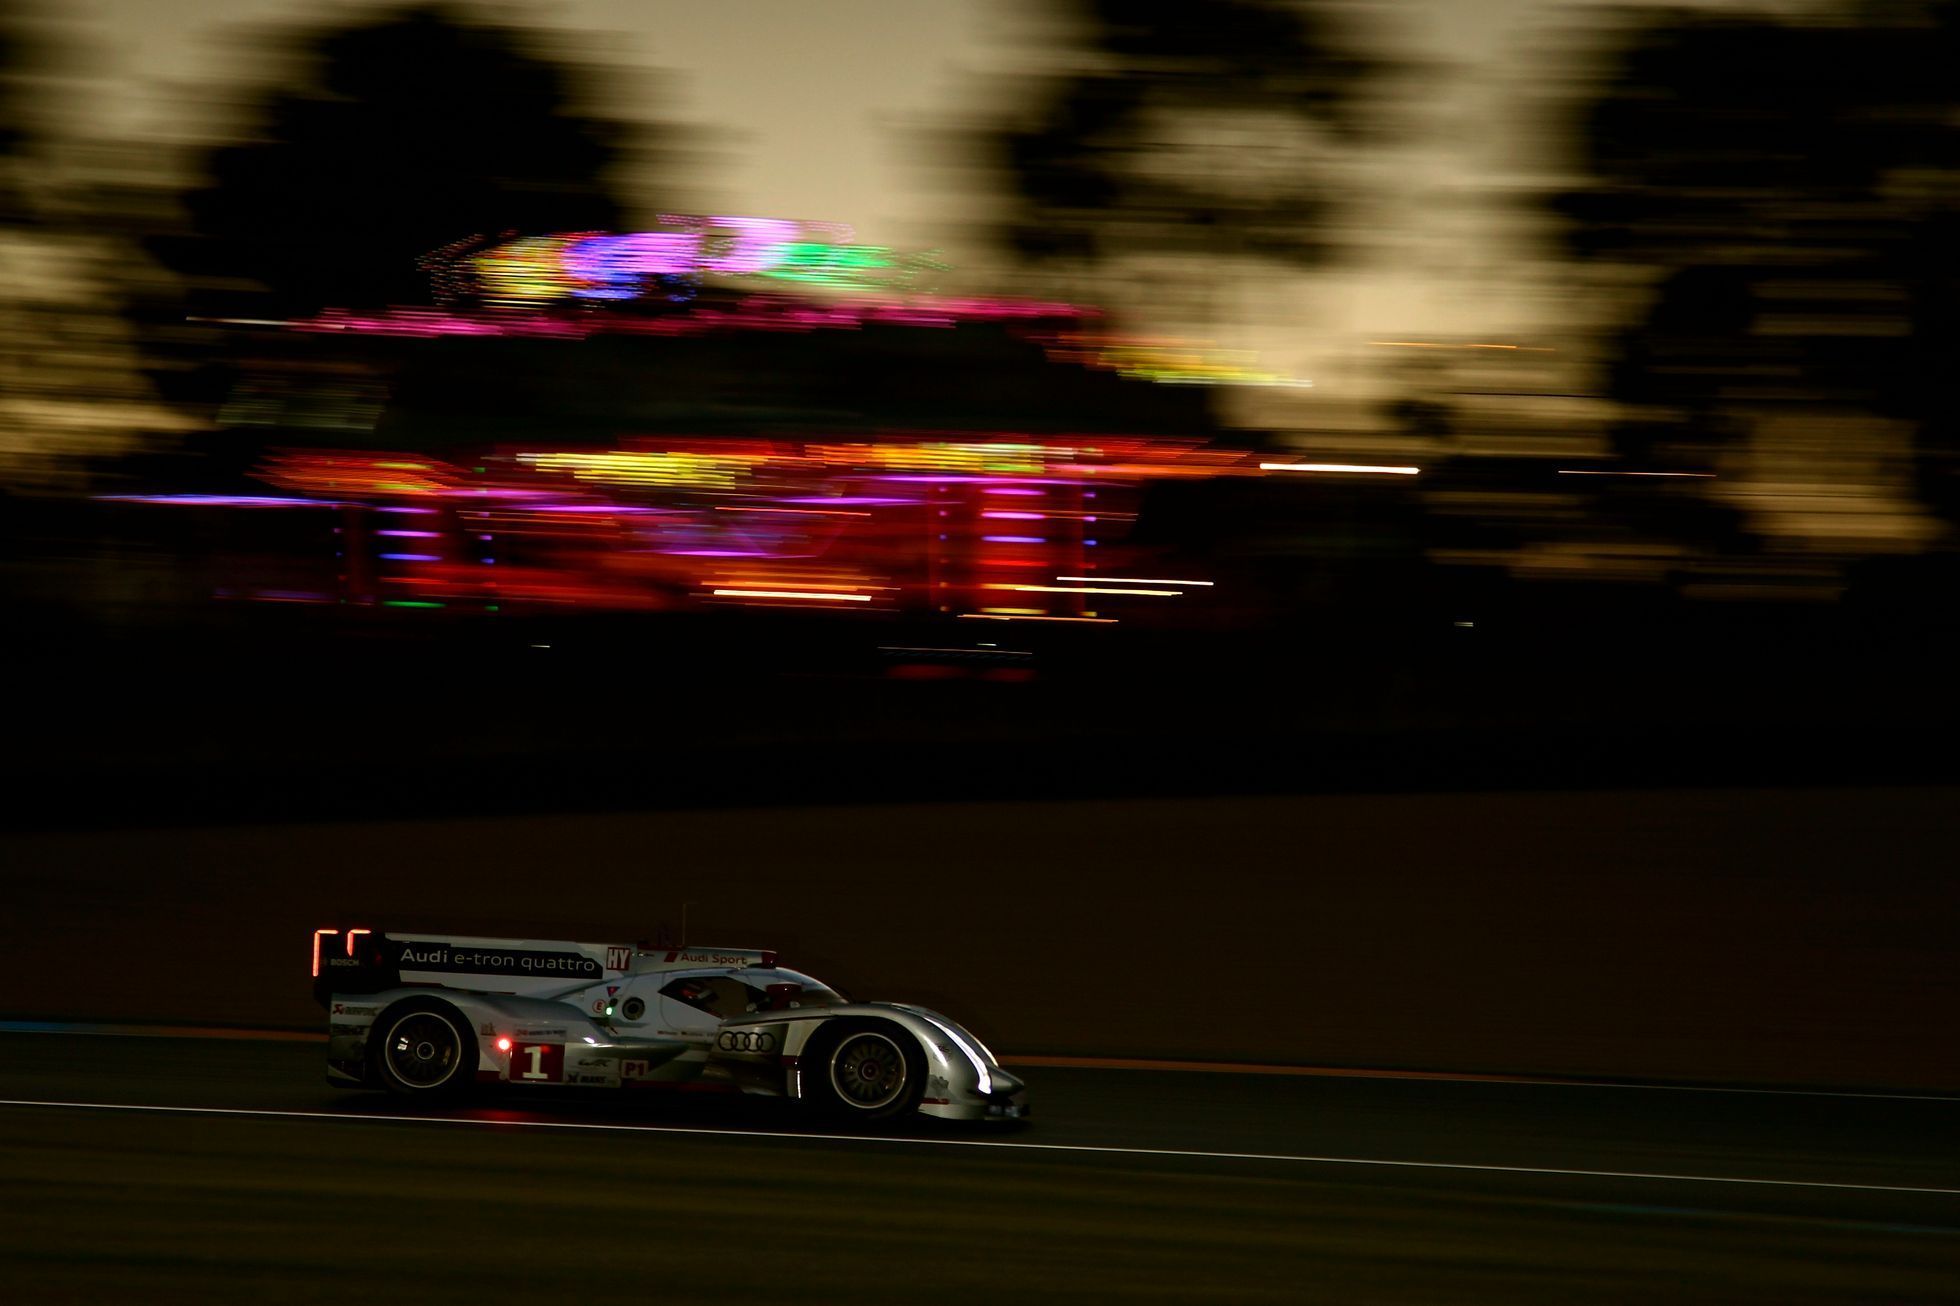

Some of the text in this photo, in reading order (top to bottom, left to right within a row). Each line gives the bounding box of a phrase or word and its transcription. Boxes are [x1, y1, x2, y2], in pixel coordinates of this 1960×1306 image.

[400, 948, 595, 972] Audi e-tron quattro
[608, 948, 630, 970] HY
[681, 951, 748, 968] Audi Sport
[522, 1045, 549, 1079] 1
[625, 1062, 645, 1076] P1
